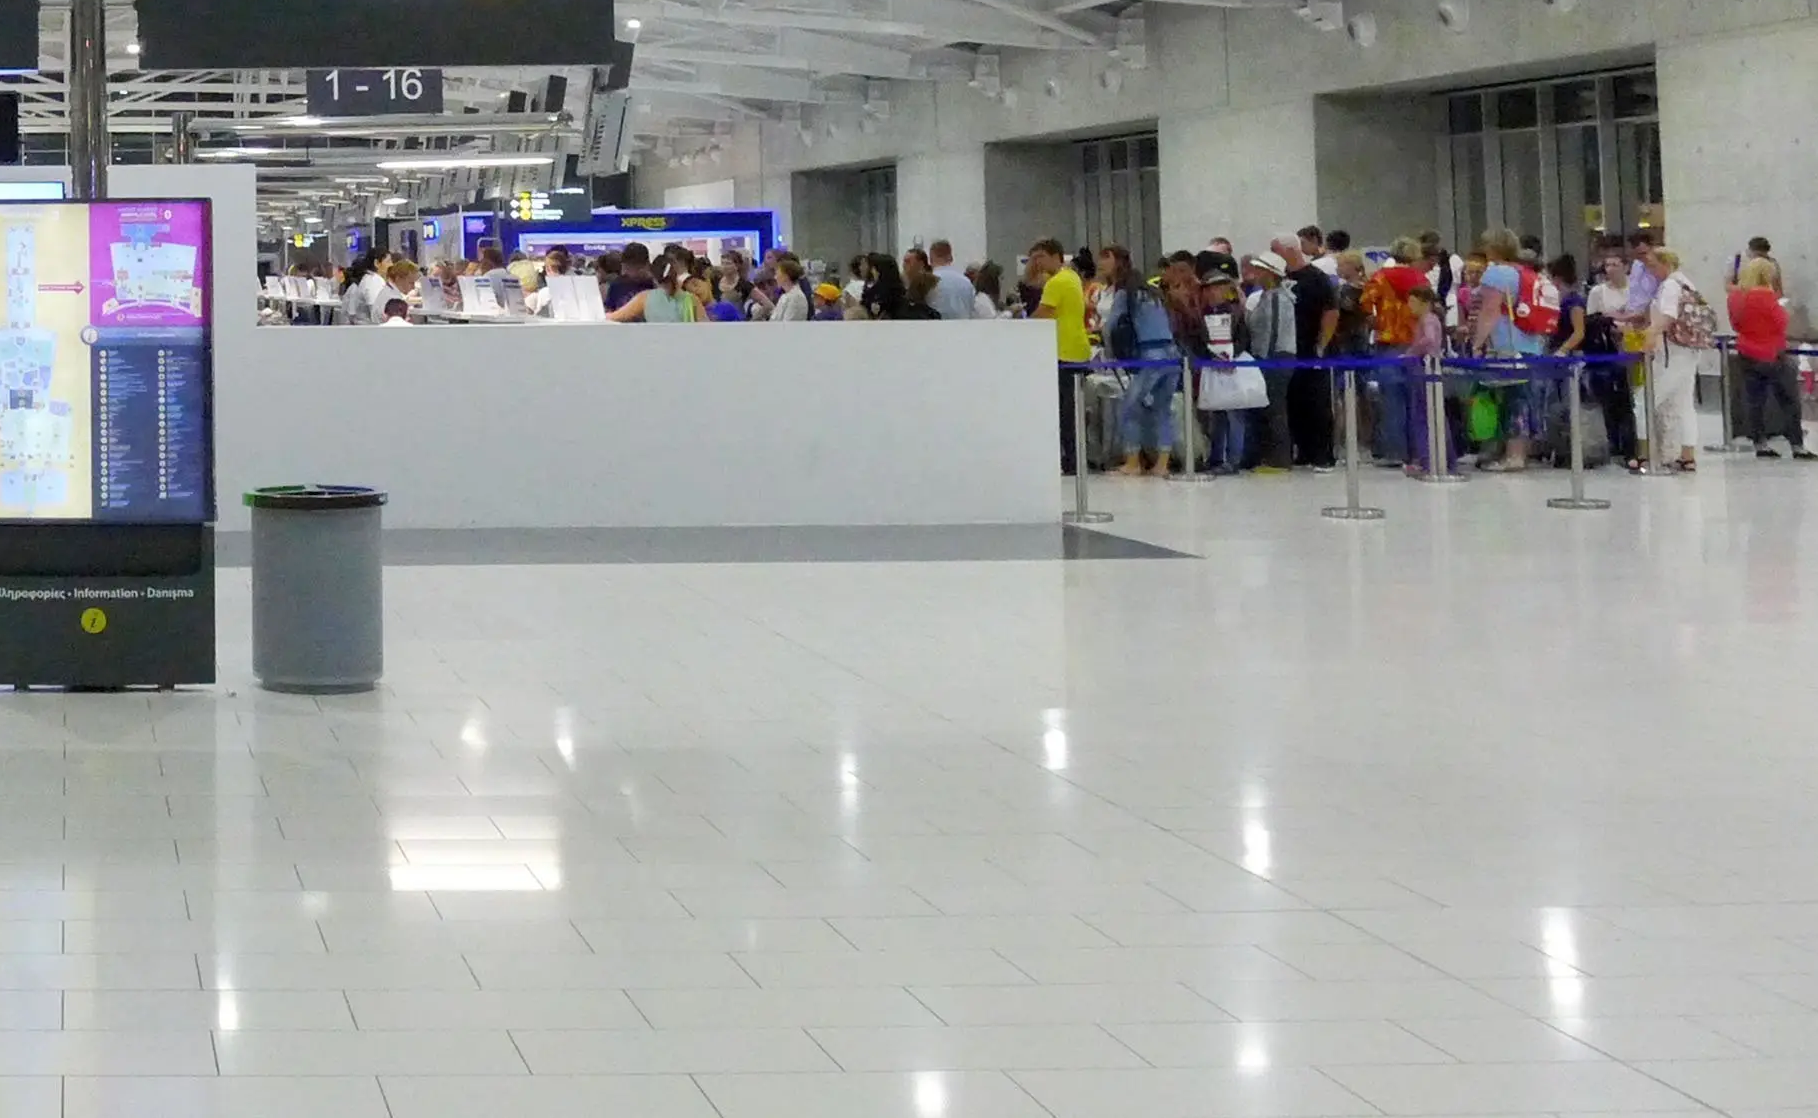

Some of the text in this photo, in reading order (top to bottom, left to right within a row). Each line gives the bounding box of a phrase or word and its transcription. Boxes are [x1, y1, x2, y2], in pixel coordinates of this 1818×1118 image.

[325, 69, 339, 101] 1
[382, 69, 423, 100] 16
[73, 587, 139, 599] Information
